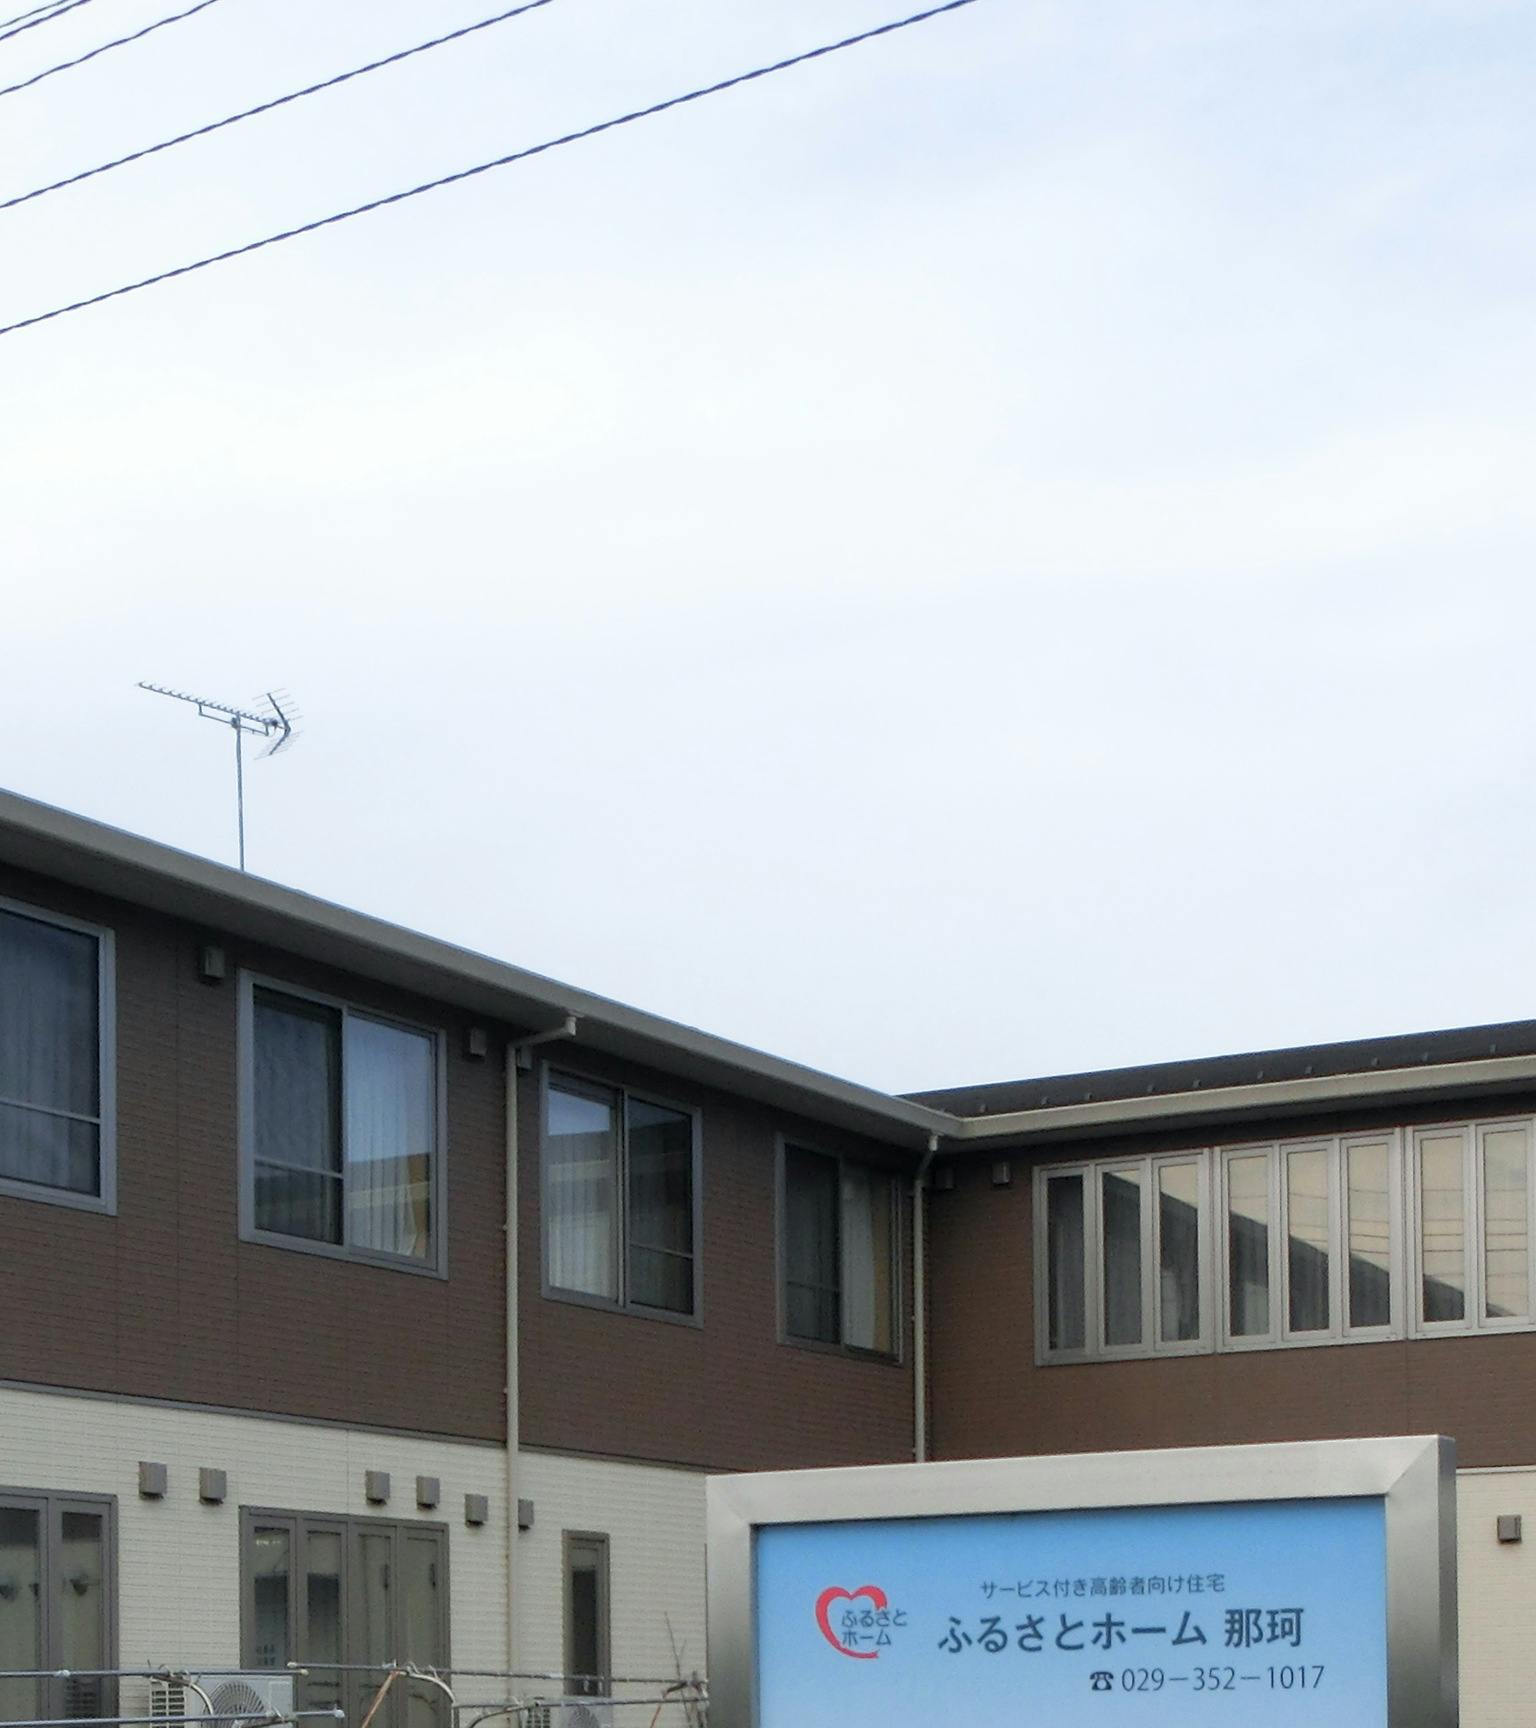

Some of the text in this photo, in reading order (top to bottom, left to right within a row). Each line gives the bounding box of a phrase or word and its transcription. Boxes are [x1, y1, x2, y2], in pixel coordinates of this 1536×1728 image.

[980, 1574, 1225, 1599] サービス付き高齢者向け住宅
[841, 1609, 908, 1628] ふるさと
[842, 1629, 892, 1647] ホーム
[937, 1607, 1304, 1653] ふるさとホーム 那珂
